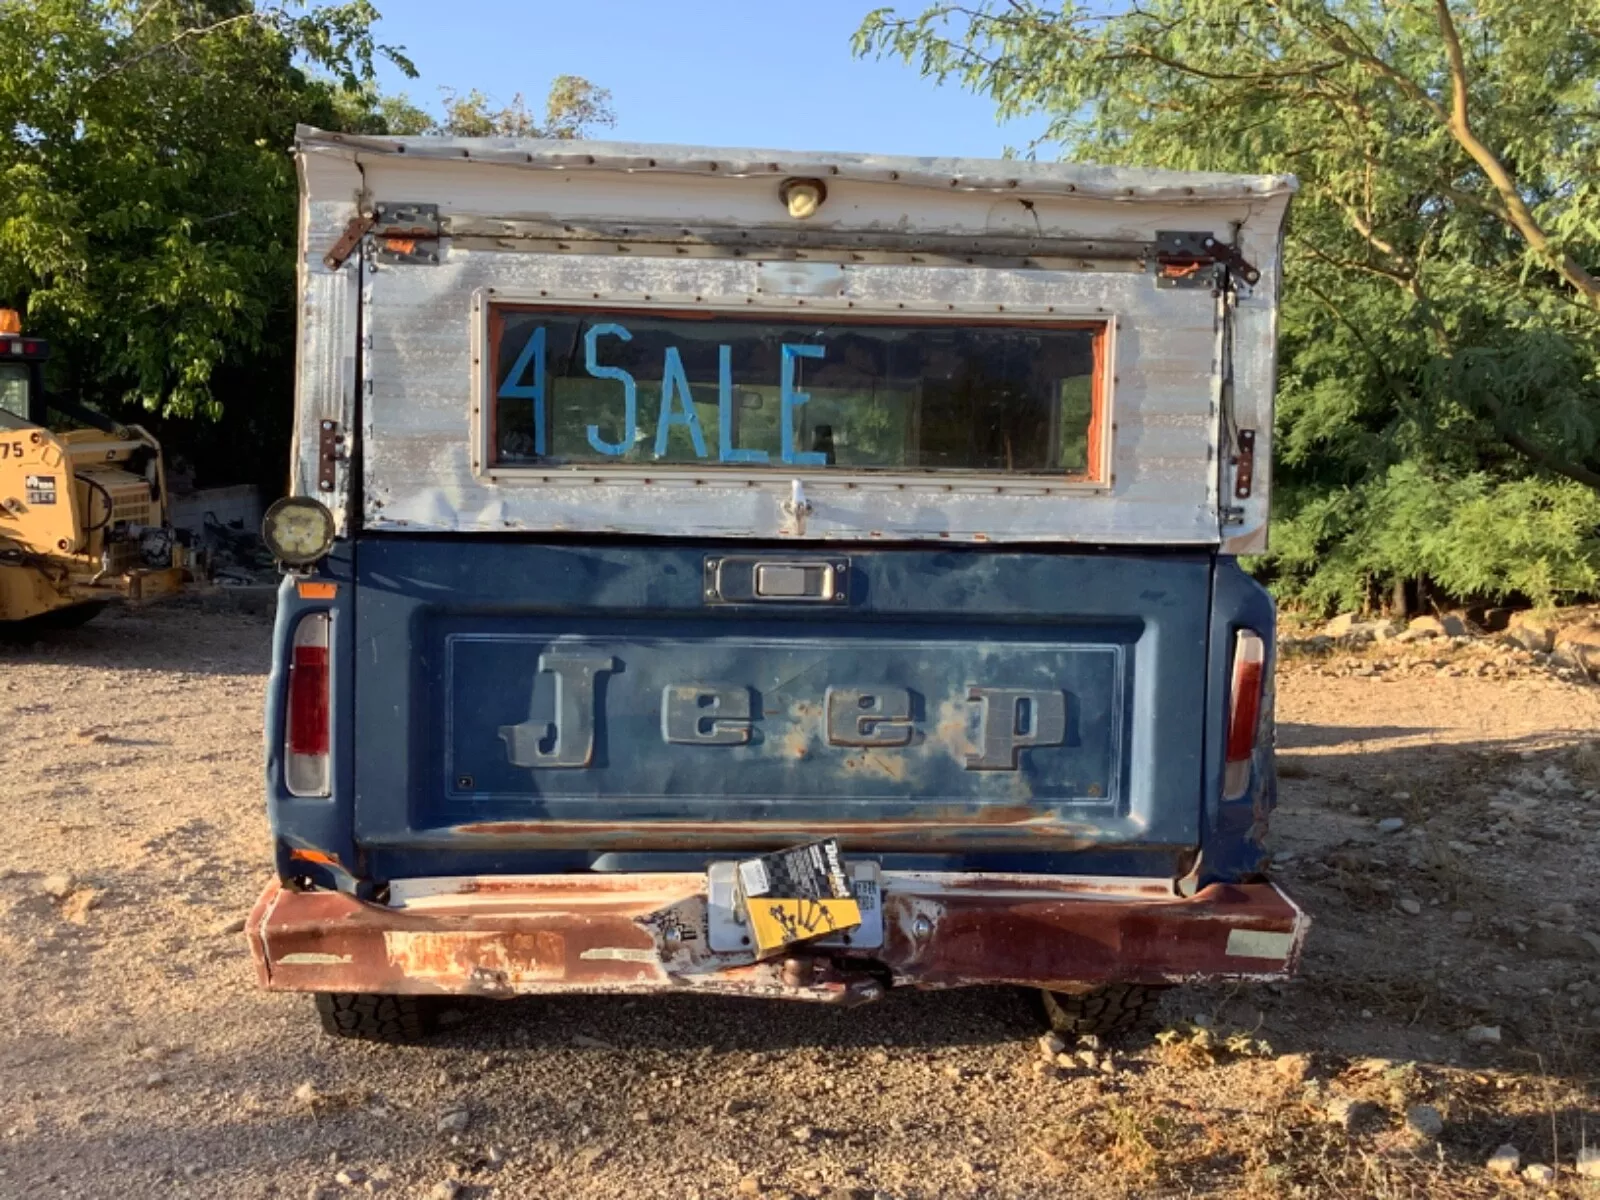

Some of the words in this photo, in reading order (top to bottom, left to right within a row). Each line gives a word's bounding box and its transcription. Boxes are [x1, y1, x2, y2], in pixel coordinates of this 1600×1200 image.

[497, 327, 546, 456] 4
[584, 323, 827, 465] SALE
[498, 652, 1066, 771] Jeep
